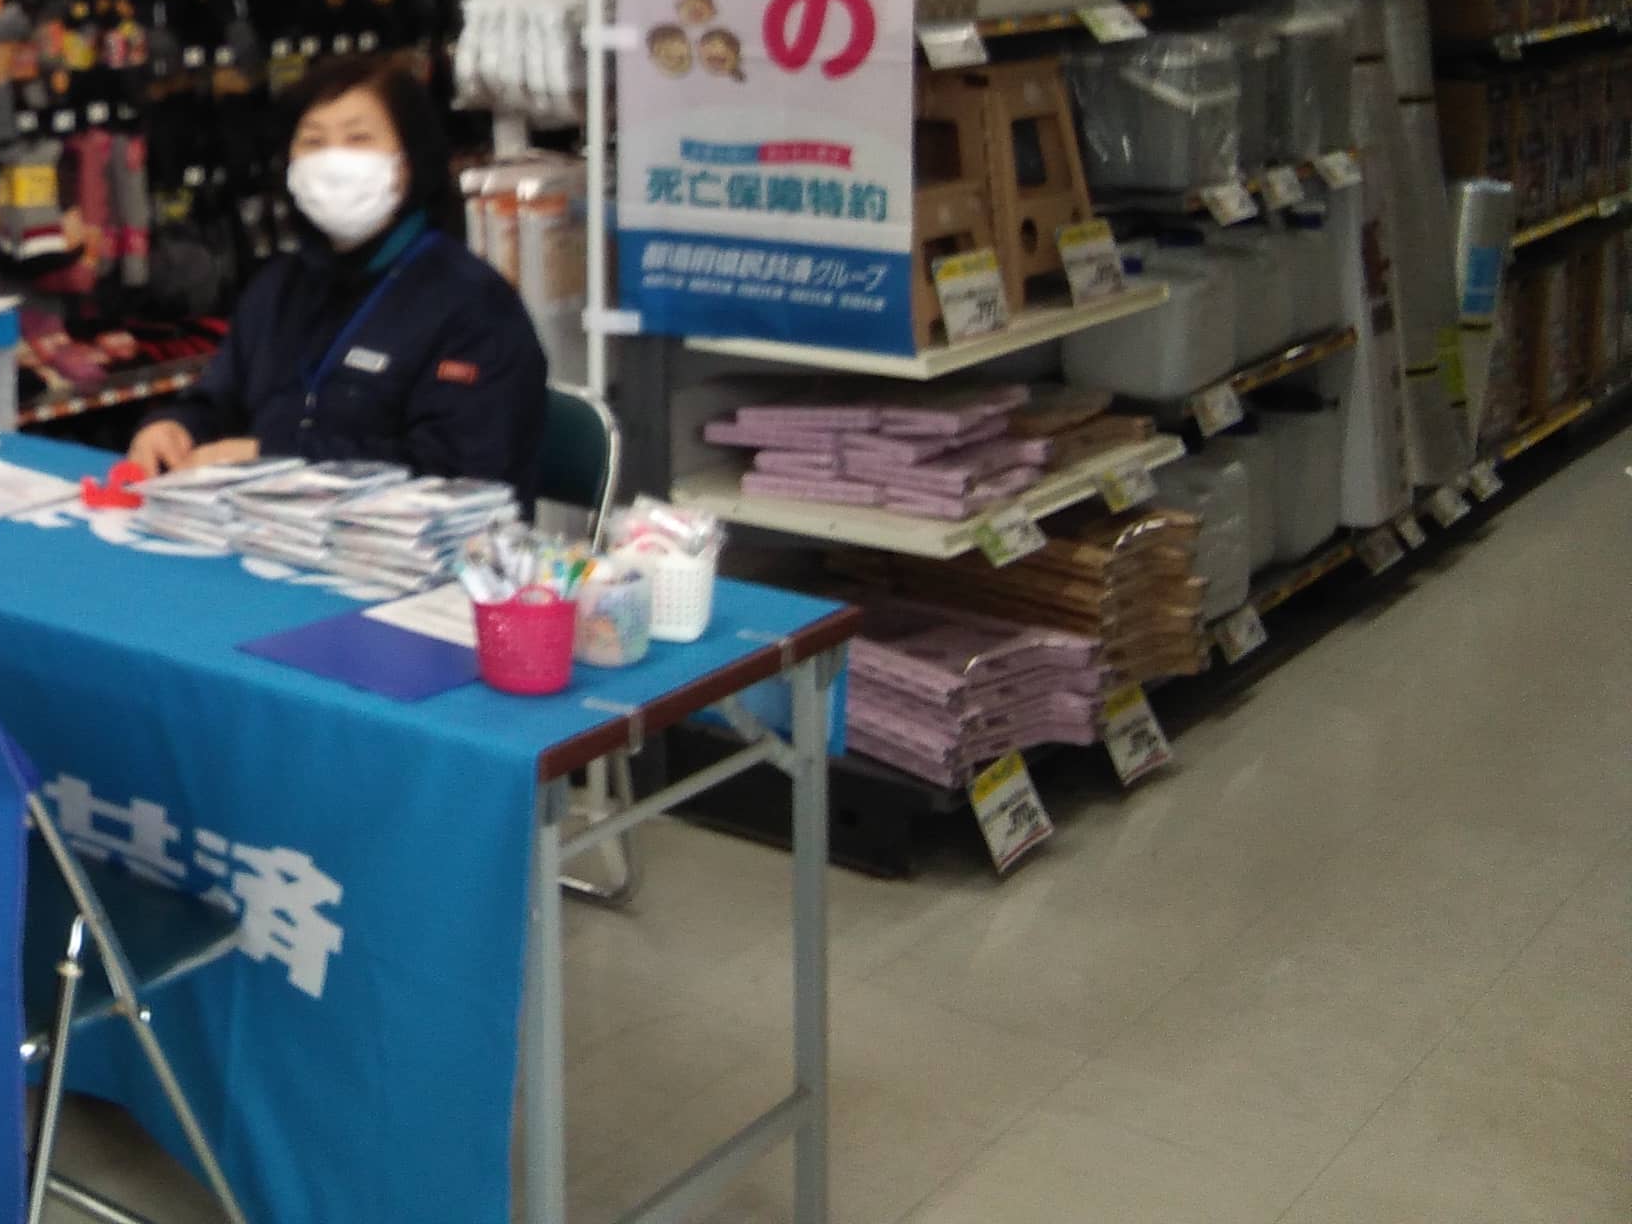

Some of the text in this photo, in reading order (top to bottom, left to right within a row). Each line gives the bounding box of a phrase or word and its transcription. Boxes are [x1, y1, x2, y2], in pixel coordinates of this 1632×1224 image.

[646, 166, 889, 224] 死亡保障特約
